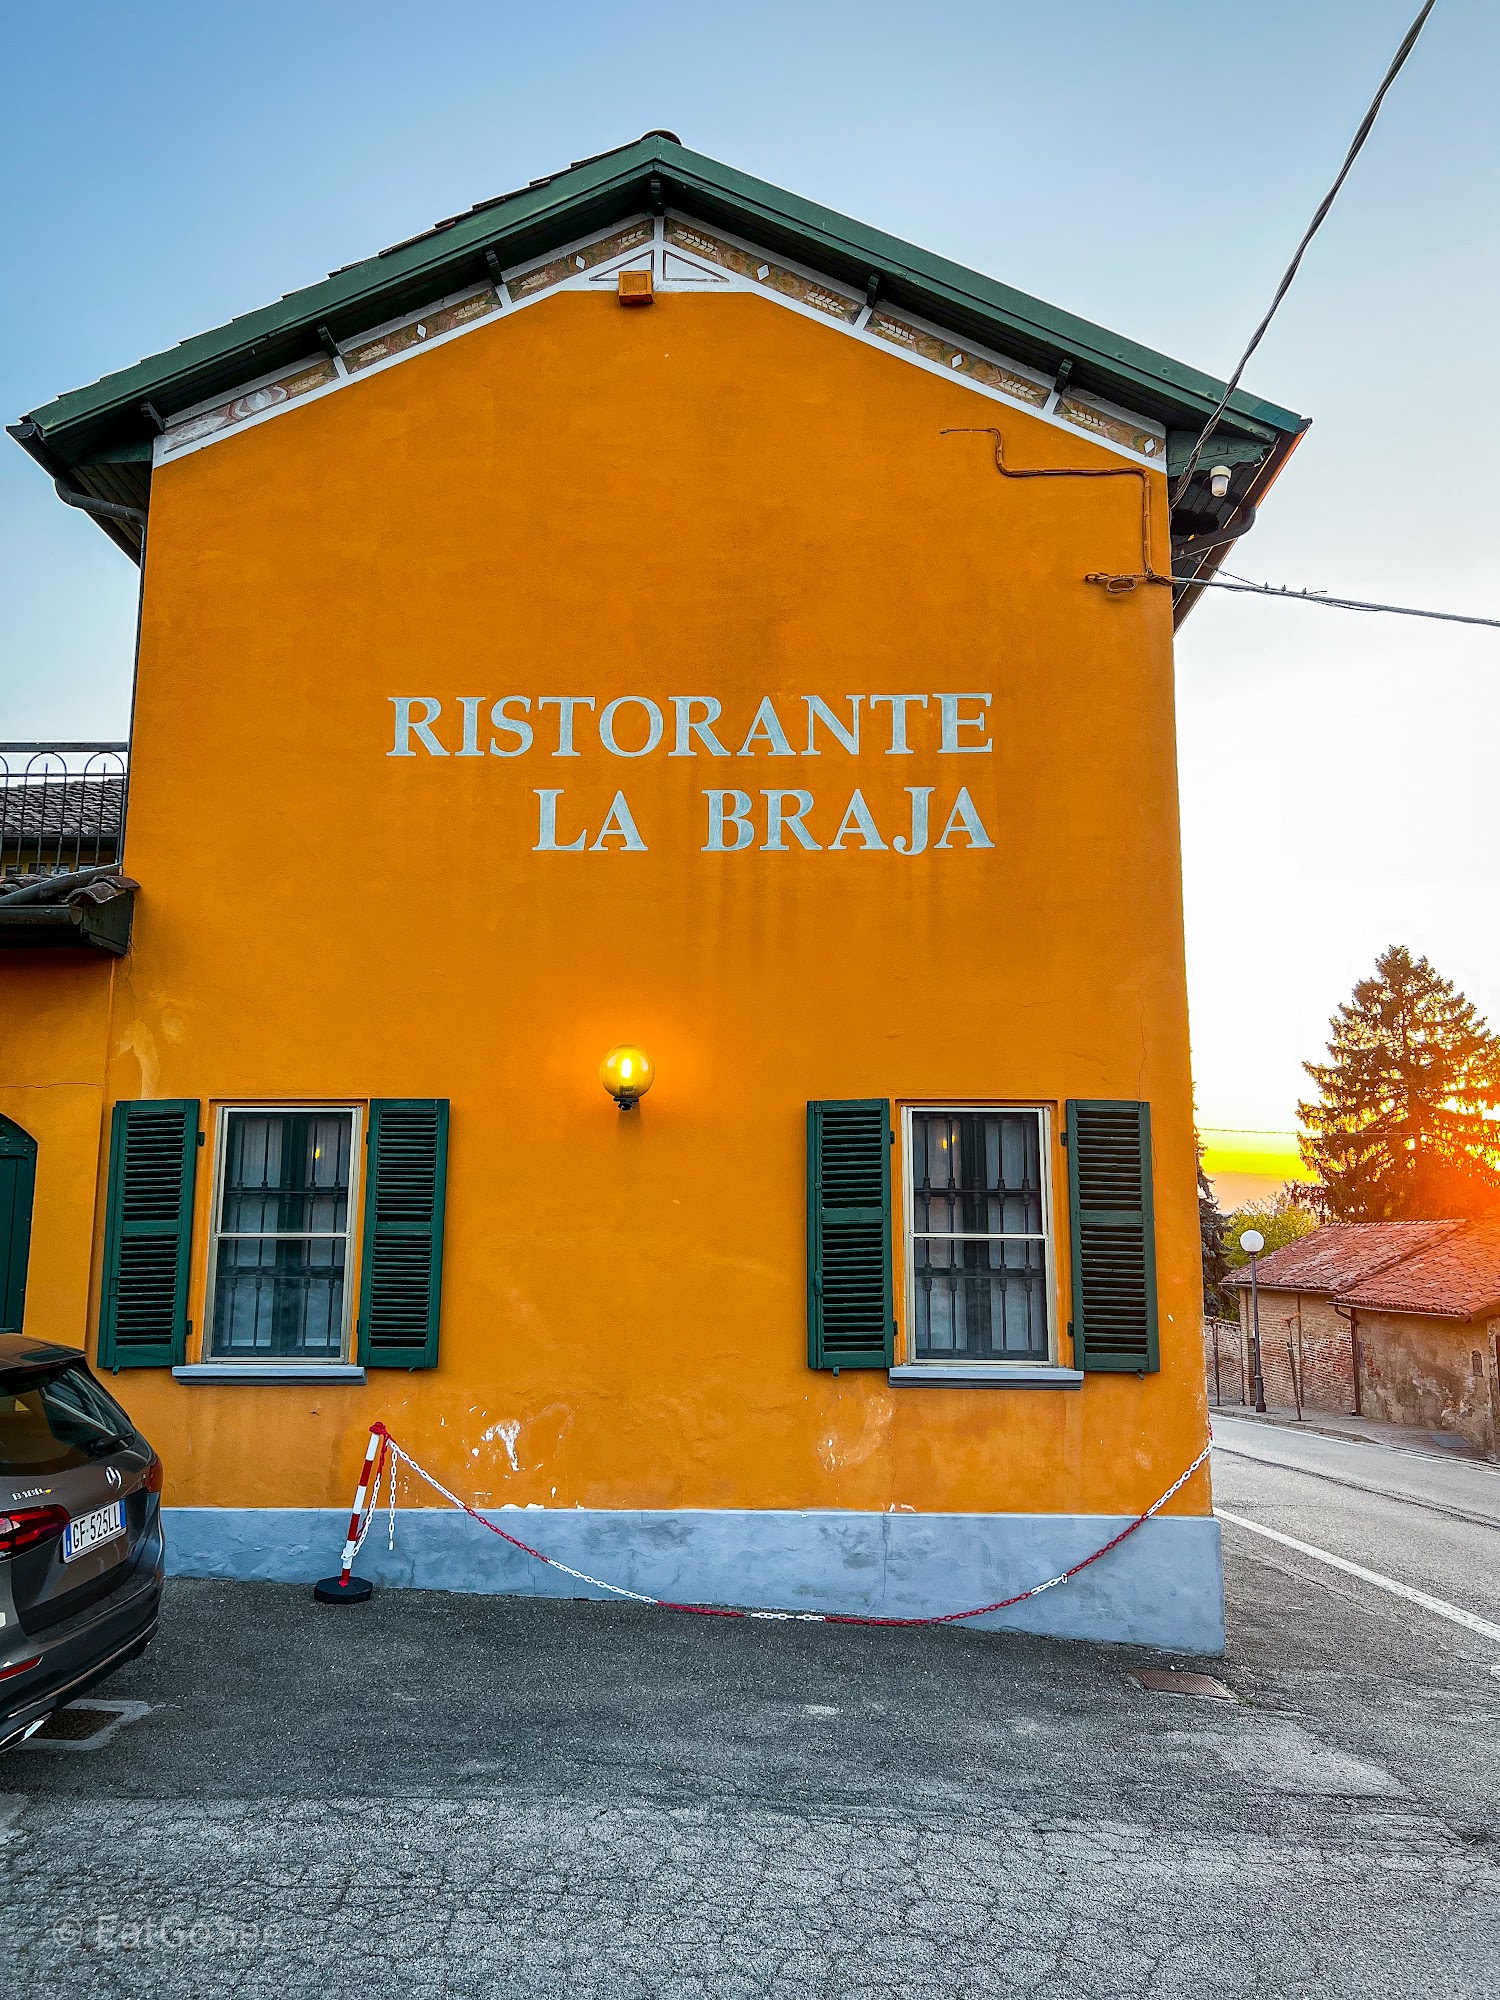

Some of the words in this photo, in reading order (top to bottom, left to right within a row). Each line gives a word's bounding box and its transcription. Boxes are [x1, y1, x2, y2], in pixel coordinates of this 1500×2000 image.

[385, 692, 994, 758] RISTORANTE
[532, 788, 649, 852] LA
[700, 786, 995, 856] BRAJA
